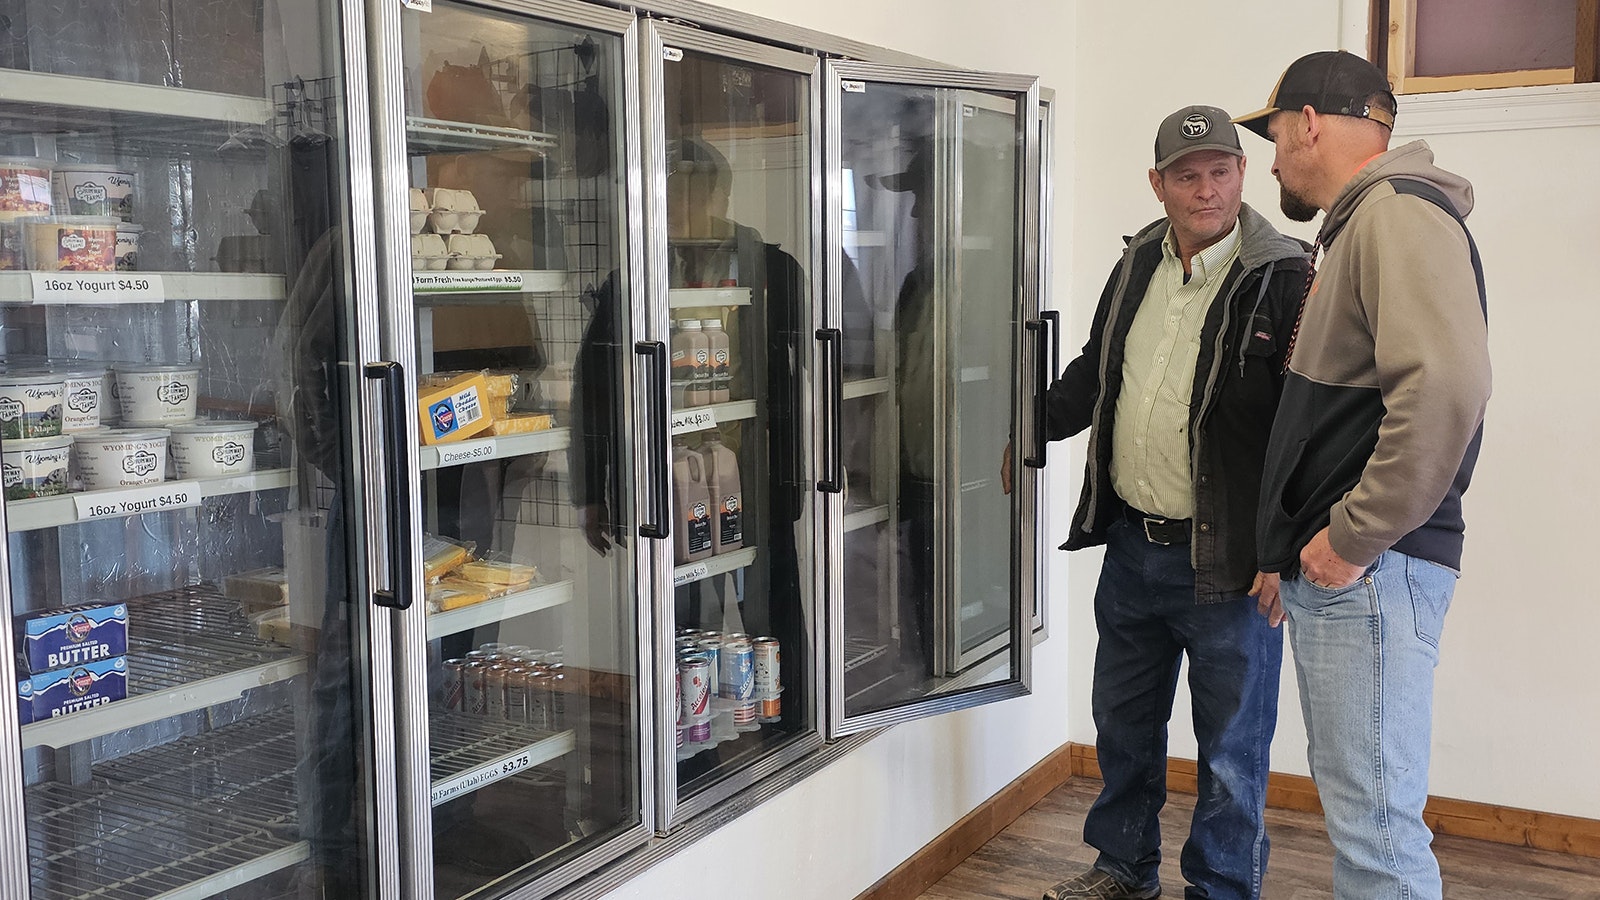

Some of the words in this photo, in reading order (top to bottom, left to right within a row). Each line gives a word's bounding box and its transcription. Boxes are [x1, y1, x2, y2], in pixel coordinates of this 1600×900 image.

[434, 276, 452, 284] Fresh
[44, 280, 73, 291] 16oz
[76, 280, 116, 293] Yogurt
[119, 280, 149, 290] $4.50
[72, 395, 95, 403] SHUMWAY
[102, 443, 147, 451] WYOMING'S
[127, 458, 154, 466] SHUMWAY
[136, 464, 154, 472] FARMS
[89, 506, 116, 516] 16oz
[120, 498, 156, 512] Yogurt
[159, 493, 188, 506] $4.50
[60, 643, 81, 651] PREMIUM
[48, 644, 110, 668] BUTTER
[64, 697, 83, 705] PREMIUM
[439, 786, 460, 798] Farms
[480, 768, 499, 780] EGGS
[502, 756, 529, 773] $3.75
